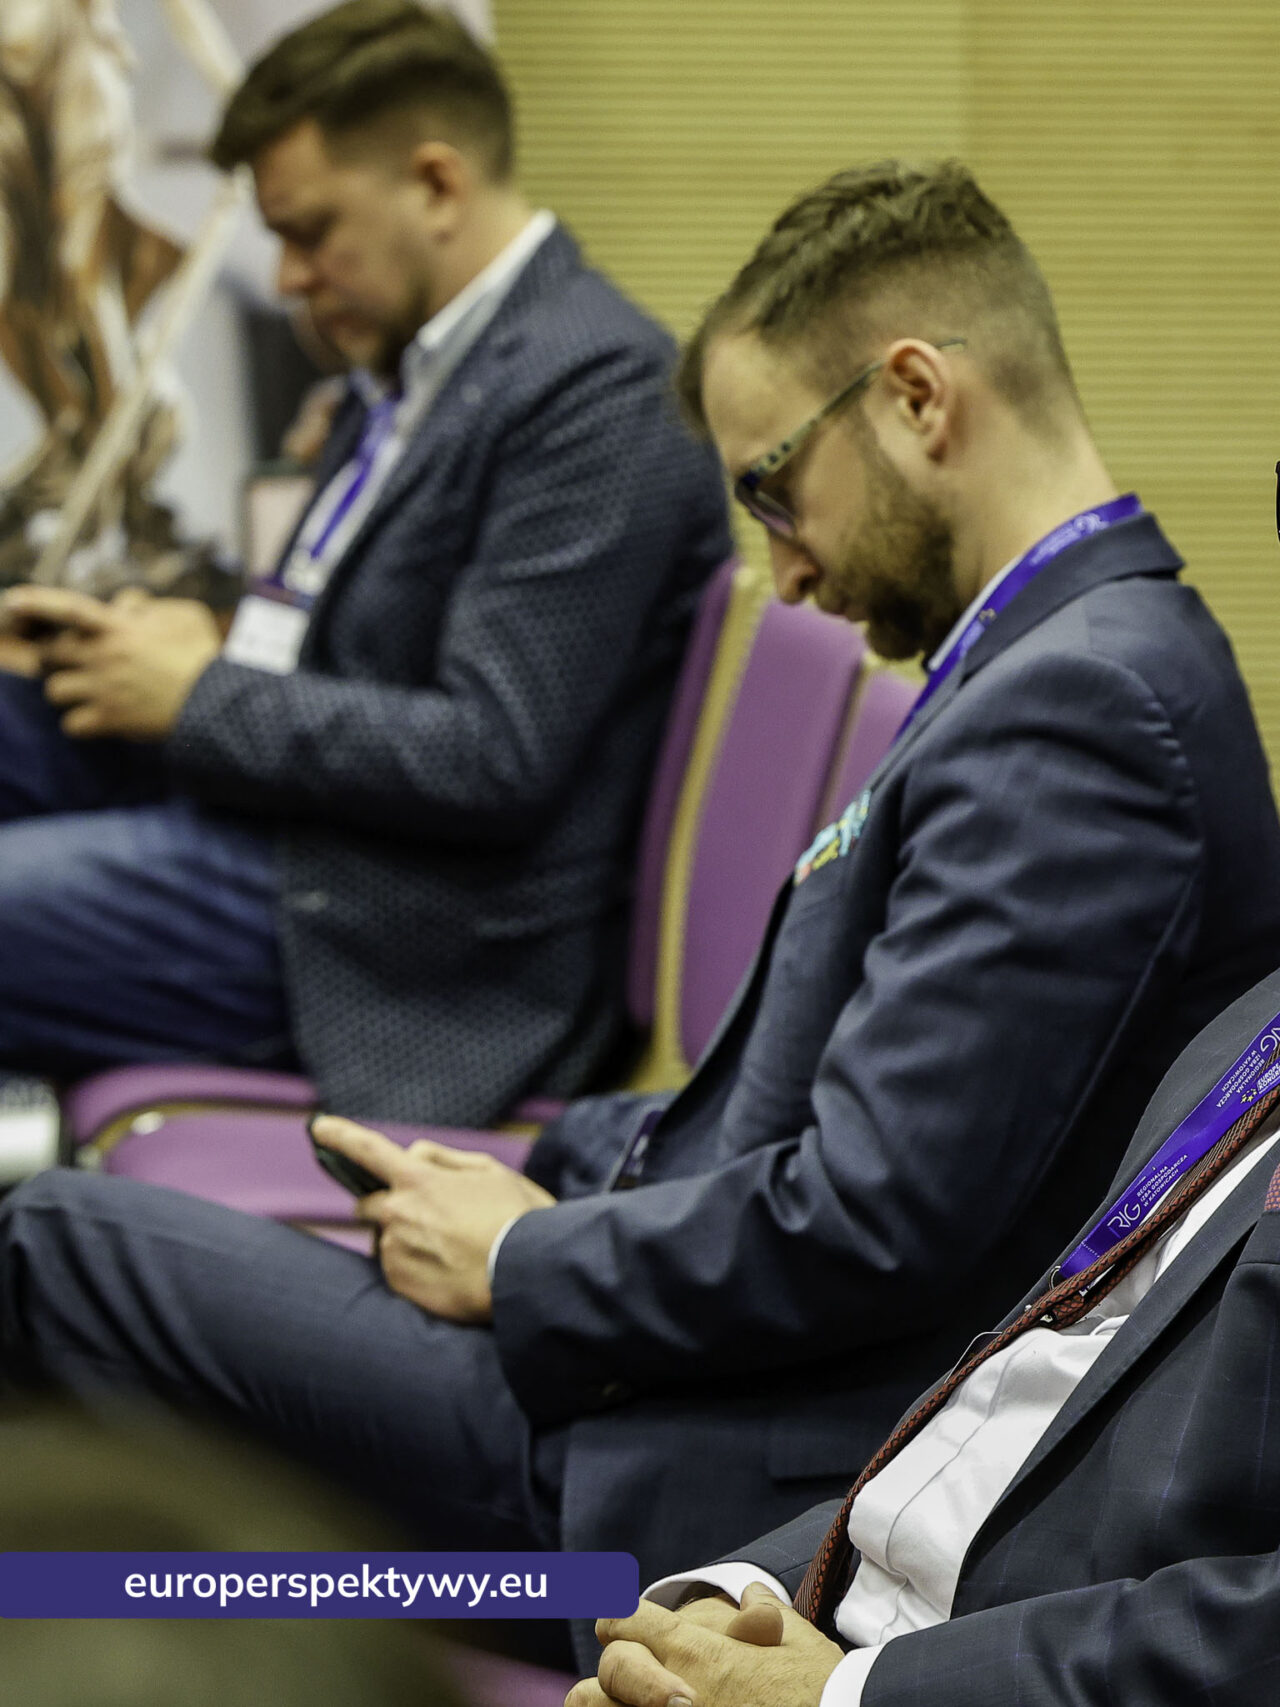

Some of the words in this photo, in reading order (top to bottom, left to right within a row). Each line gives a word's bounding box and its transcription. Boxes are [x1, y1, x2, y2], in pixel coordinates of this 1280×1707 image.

[1216, 1067, 1250, 1108] GOSPODARCZA
[1221, 1055, 1252, 1093] KATOWICACH
[1236, 1058, 1265, 1094] REGIONALNA
[1136, 1166, 1168, 1197] REGIONALNA
[1148, 1169, 1179, 1202] KATOWICACH
[1151, 1154, 1188, 1190] GOSPODARCZA
[1107, 1203, 1141, 1228] RIG
